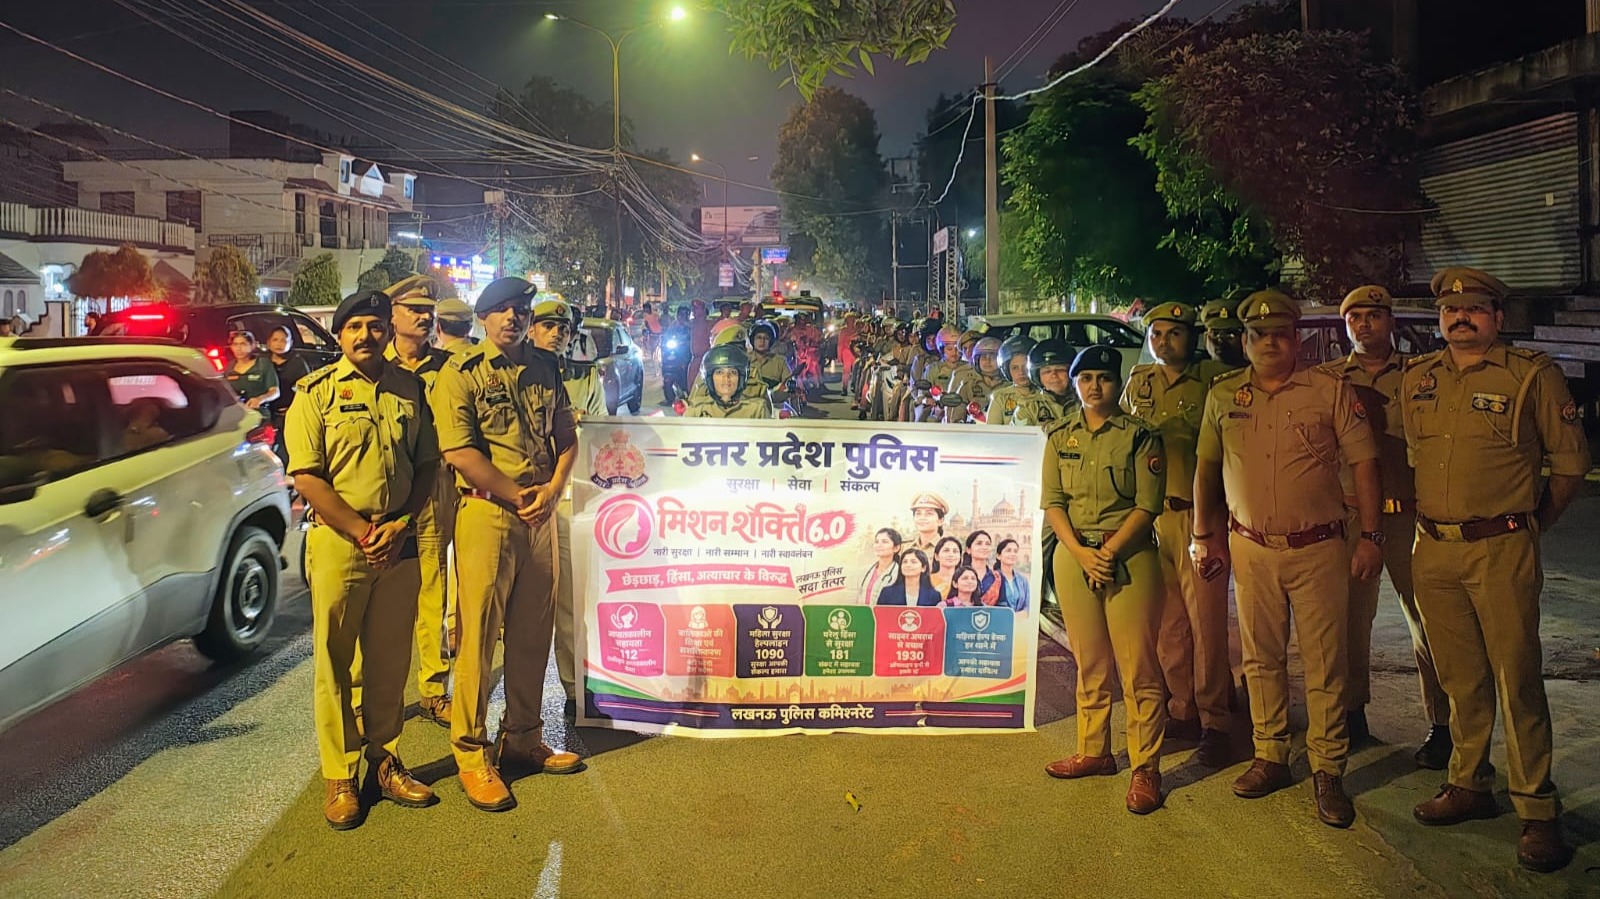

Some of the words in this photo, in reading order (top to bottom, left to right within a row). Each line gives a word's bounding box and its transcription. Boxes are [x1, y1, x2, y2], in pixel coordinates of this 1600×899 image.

[681, 441, 749, 467] उत्तर
[756, 432, 835, 469] प्रदेश
[842, 434, 938, 479] पुलिस
[727, 477, 760, 493] सुरक्षा
[787, 476, 812, 491] सेवा
[840, 477, 880, 493] संकल्प
[657, 497, 729, 540] मिशन
[731, 502, 806, 544] शक्ति
[808, 516, 847, 543] 6.0
[653, 546, 669, 557] नारी
[671, 548, 693, 559] सुरक्षा
[705, 547, 721, 558] नारी
[723, 549, 749, 558] सम्मान
[761, 548, 776, 558] नारी
[696, 570, 741, 581] अत्याचार
[743, 567, 755, 581] के
[758, 569, 788, 584] विरुद्ध
[822, 566, 843, 577] पुलिस
[798, 581, 818, 594] सदा
[821, 576, 846, 588] तत्पर
[749, 629, 771, 638] महिला
[772, 630, 792, 639] सुरक्षा
[620, 649, 638, 660] 112
[755, 649, 784, 660] 1090
[830, 649, 849, 660] 181
[896, 651, 924, 660] 1930
[731, 708, 777, 721] लखनऊ
[780, 705, 815, 724] पुलिस
[818, 704, 875, 720] कमिश्नरेट
